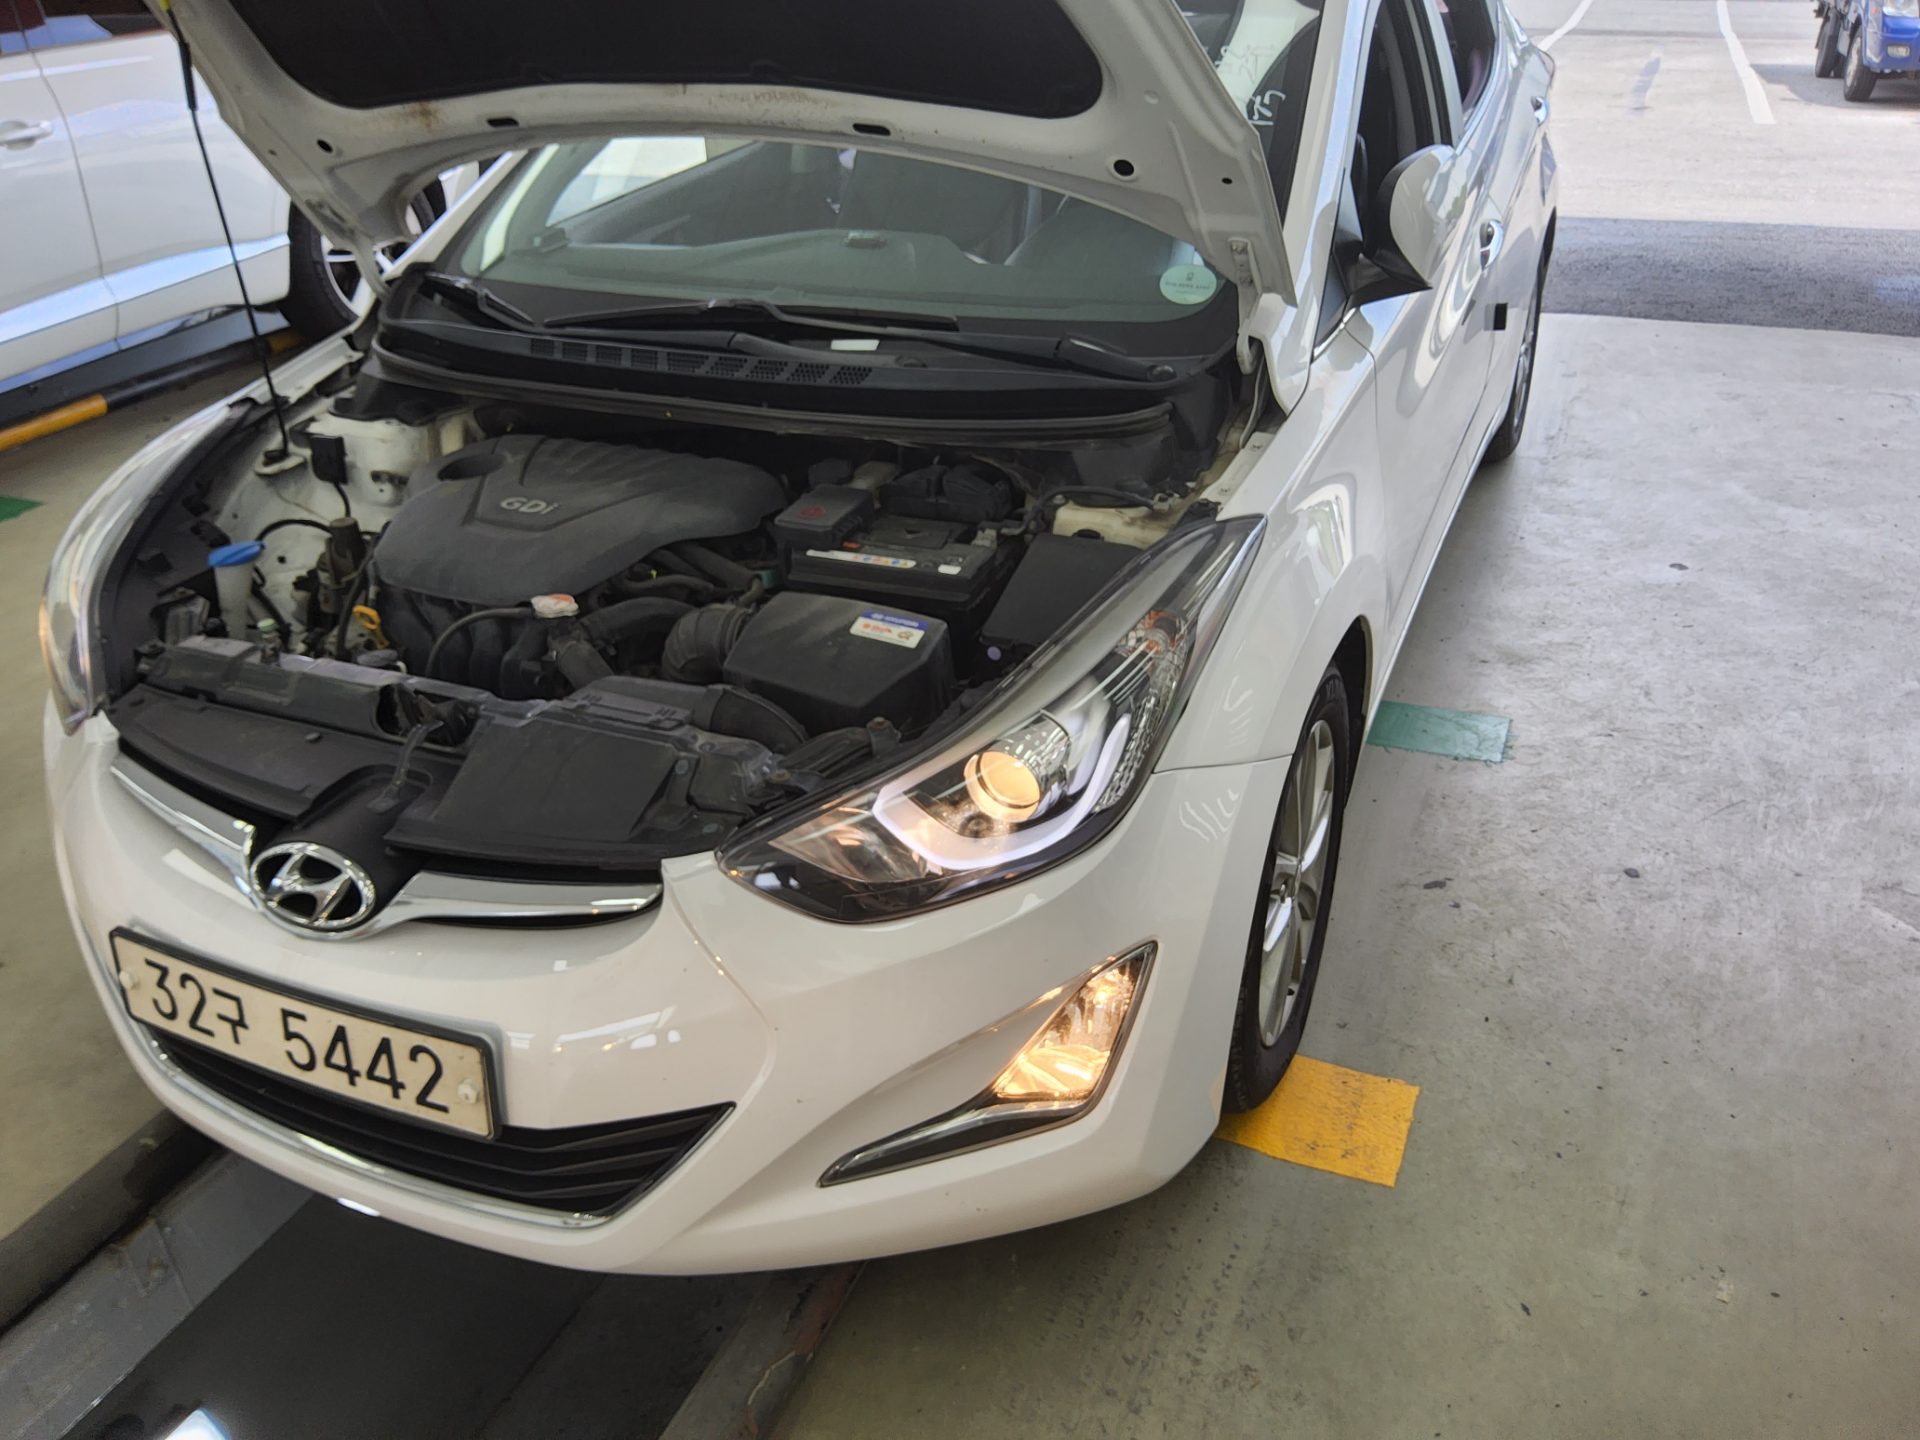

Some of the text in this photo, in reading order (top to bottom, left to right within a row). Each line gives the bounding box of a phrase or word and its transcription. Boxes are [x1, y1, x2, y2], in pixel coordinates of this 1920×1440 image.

[500, 496, 559, 514] GDi
[144, 958, 449, 1114] 32구 5442
